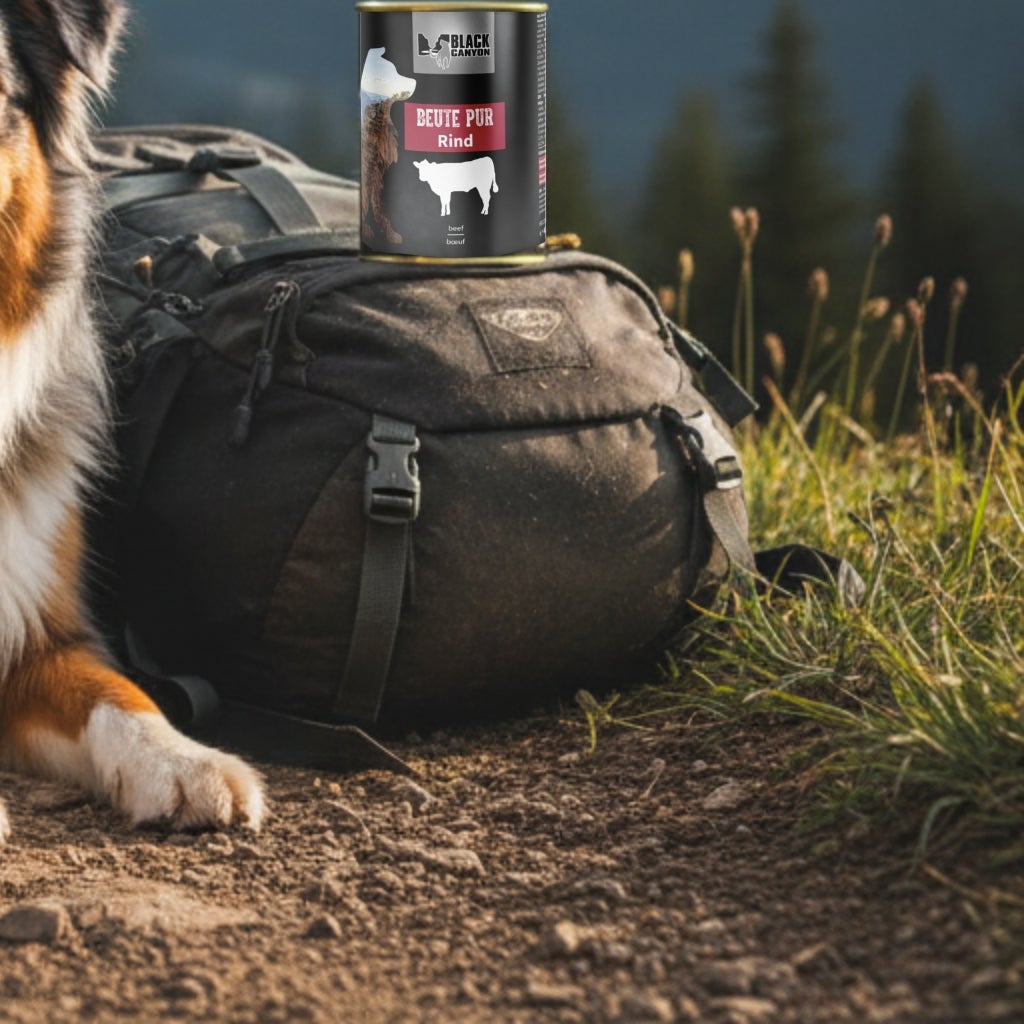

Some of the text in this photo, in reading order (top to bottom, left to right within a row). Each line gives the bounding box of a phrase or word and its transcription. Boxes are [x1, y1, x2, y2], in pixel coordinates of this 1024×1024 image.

[451, 34, 490, 48] BLACK
[451, 49, 490, 57] CANYON
[417, 107, 494, 128] BEUTE PUR
[438, 134, 473, 148] Rind
